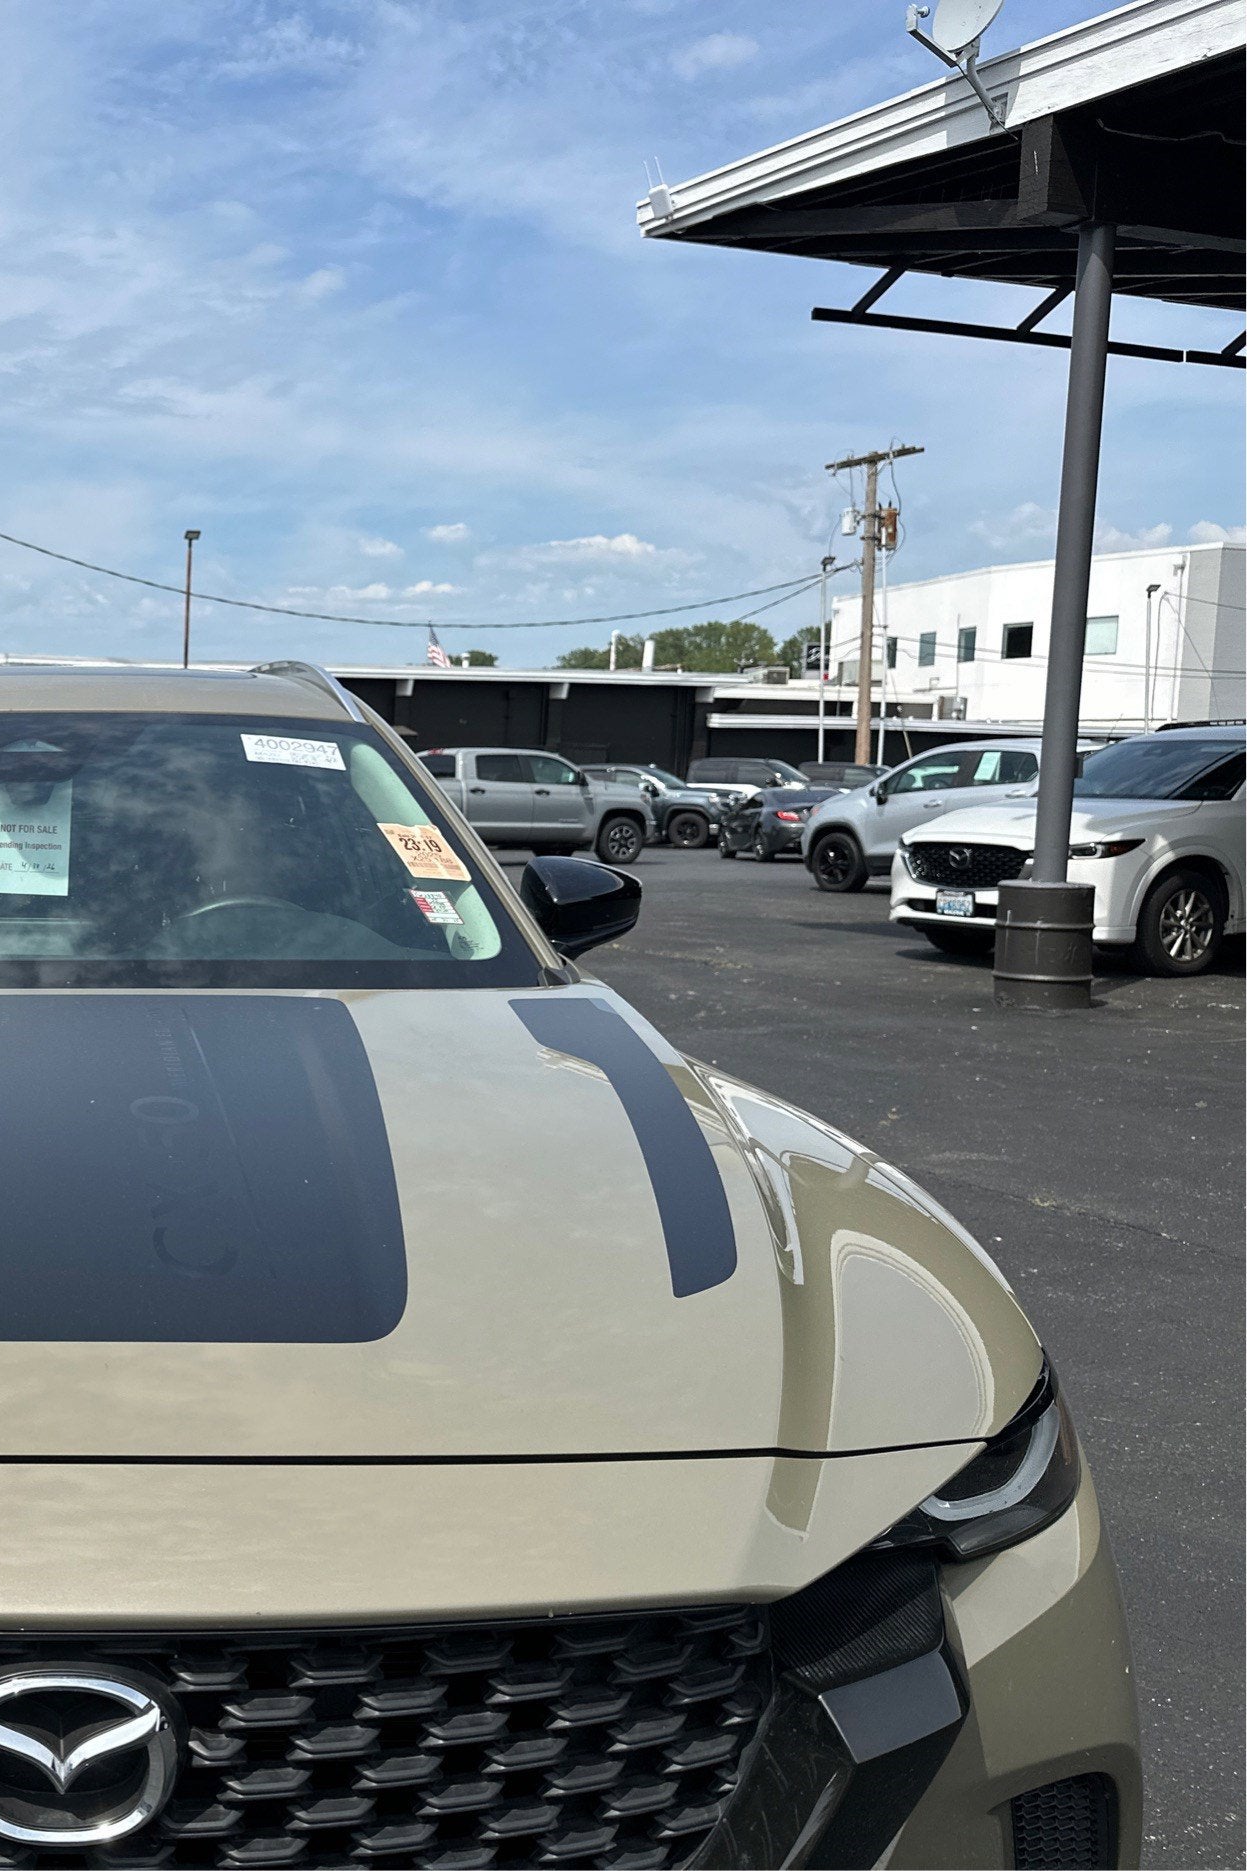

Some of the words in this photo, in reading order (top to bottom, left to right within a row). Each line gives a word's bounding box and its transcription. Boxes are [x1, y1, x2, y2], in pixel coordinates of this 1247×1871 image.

[254, 738, 338, 755] 4002947
[0, 824, 16, 833] NOT
[18, 824, 35, 833] FOR
[37, 825, 58, 834] SALE
[25, 841, 62, 851] Inspection
